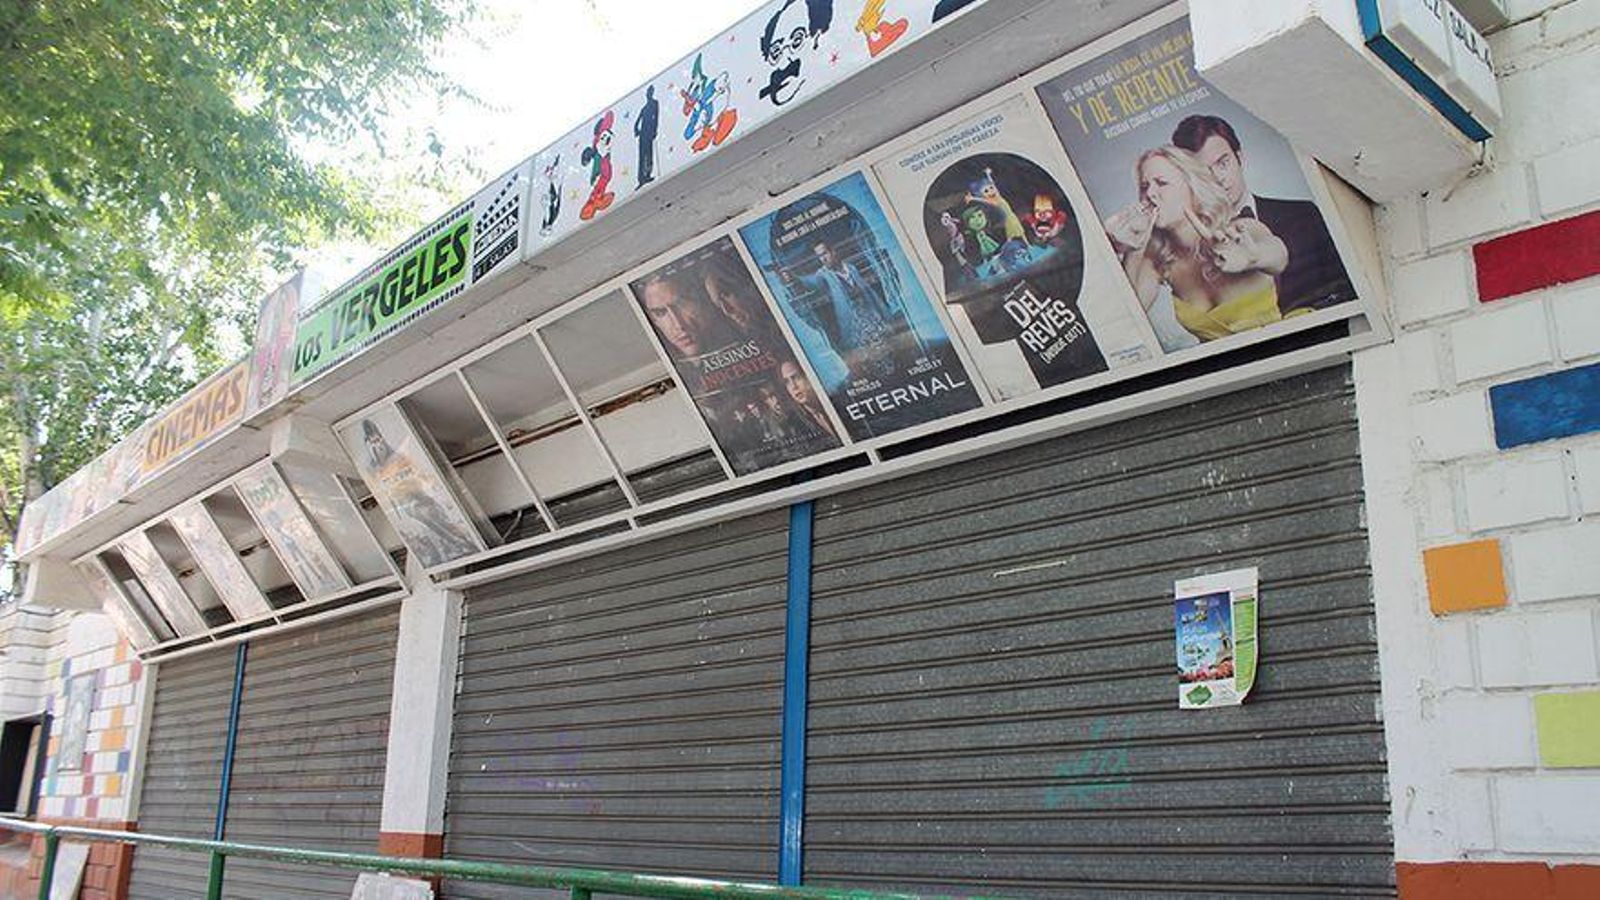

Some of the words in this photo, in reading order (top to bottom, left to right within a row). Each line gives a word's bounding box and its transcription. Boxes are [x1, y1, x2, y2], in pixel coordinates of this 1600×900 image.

[1069, 103, 1089, 135] Y
[1087, 91, 1118, 126] DE
[1113, 55, 1197, 116] REPENTE
[294, 332, 322, 373] LOS
[331, 222, 469, 350] VERGELES
[1004, 289, 1051, 329] DEL
[701, 351, 777, 391] INOCENTES
[703, 340, 760, 374] ASESINOS
[146, 369, 244, 465] CINEMAS
[846, 372, 966, 421] ETERNAL
